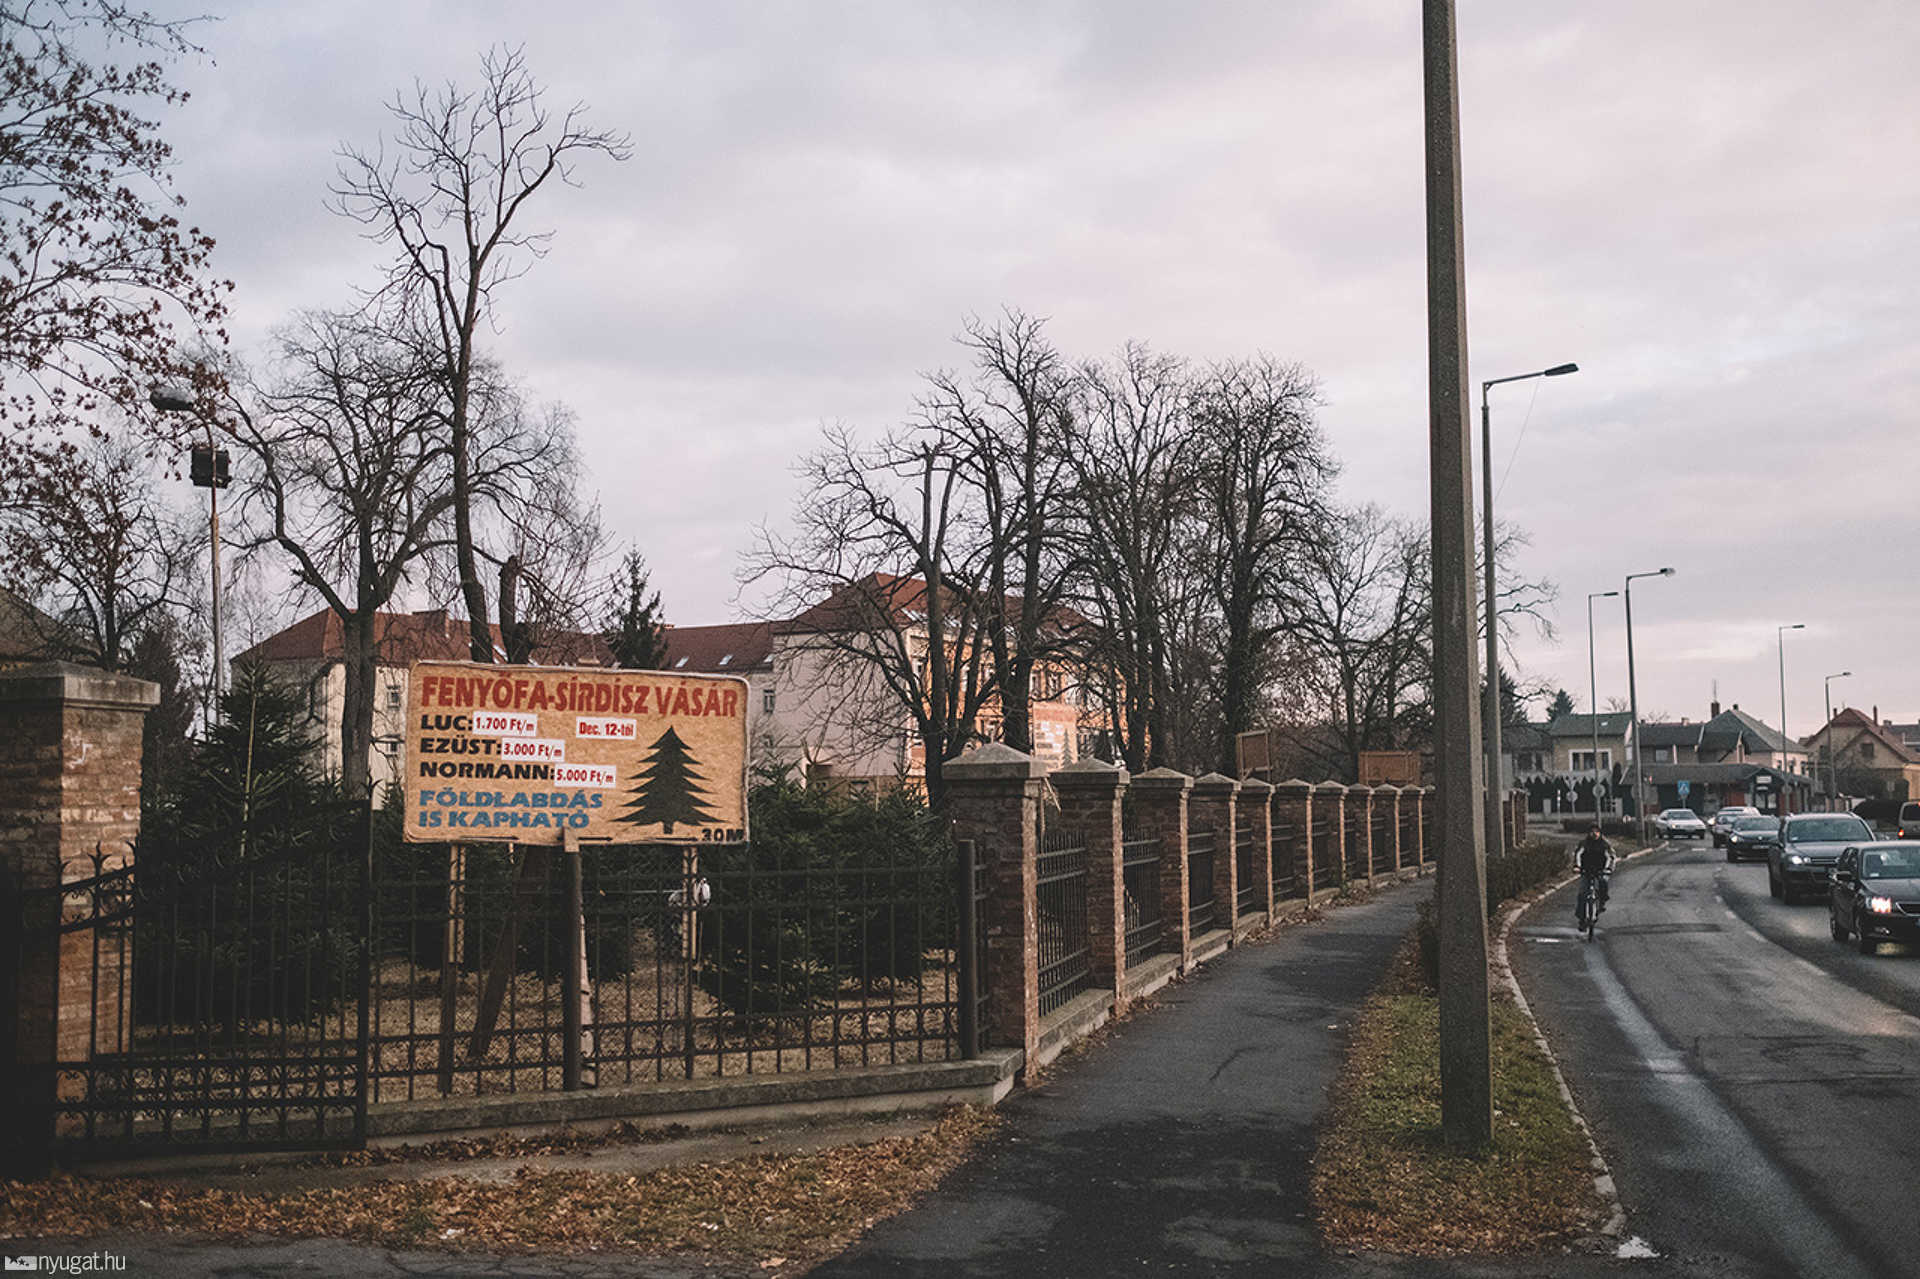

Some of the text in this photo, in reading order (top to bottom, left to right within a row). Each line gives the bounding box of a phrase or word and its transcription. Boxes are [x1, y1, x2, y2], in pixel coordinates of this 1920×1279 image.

[421, 672, 737, 717] FENYŐFA-SÍRDÍSZ VÁSÁR
[420, 714, 535, 734] LUC: 1.700 Ft/m
[579, 721, 601, 735] Dec.
[420, 735, 563, 758] EZÜST: 3.000 Ft/m
[420, 762, 614, 785] NORMANN: 5.000 Ft/m
[418, 809, 590, 829] IS KAPHATÓ
